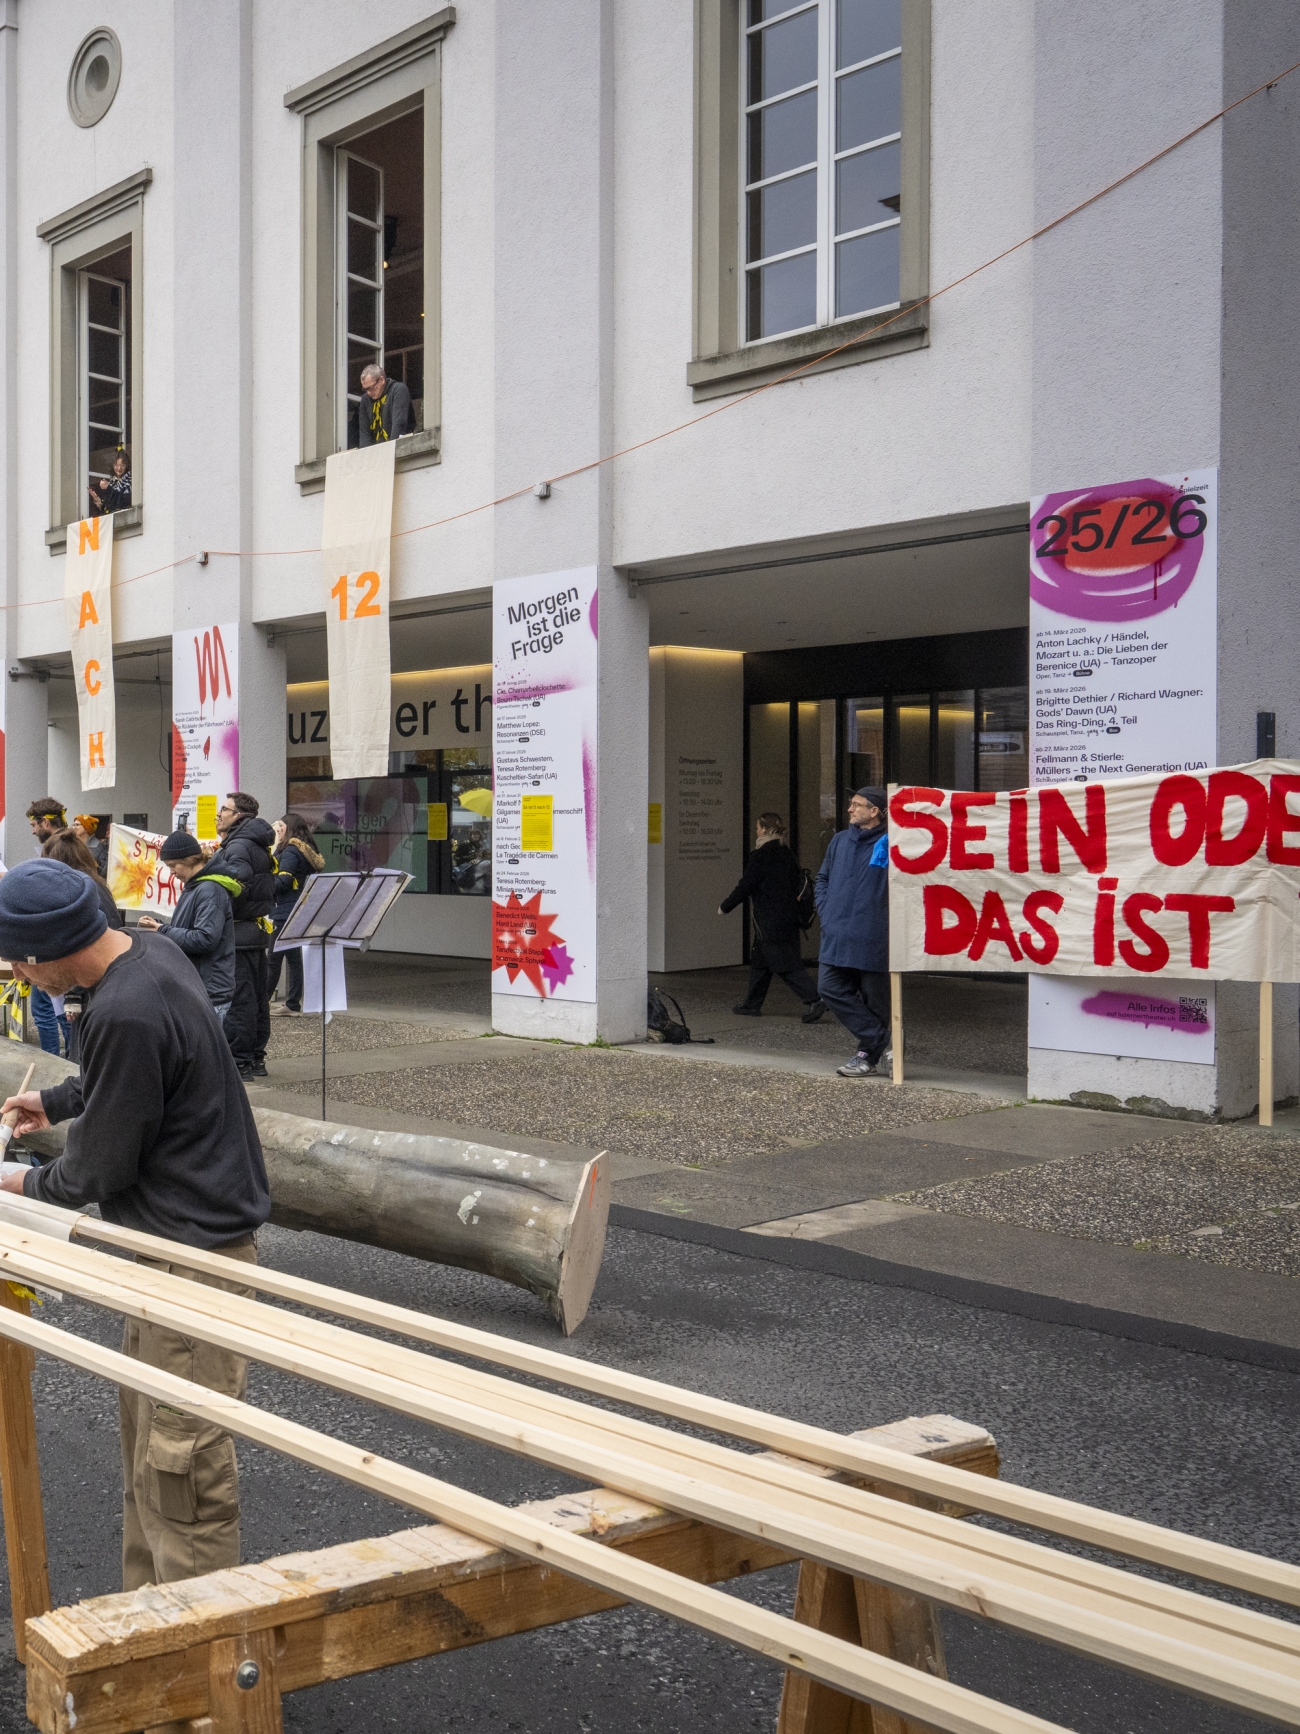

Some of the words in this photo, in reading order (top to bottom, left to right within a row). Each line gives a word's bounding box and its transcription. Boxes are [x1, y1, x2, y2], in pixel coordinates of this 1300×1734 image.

[1179, 484, 1209, 494] Spielzeit
[1036, 494, 1208, 558] 25/26
[331, 571, 381, 621] 12
[507, 587, 579, 625] Morgen
[527, 617, 549, 638] ist
[553, 607, 581, 628] die
[79, 516, 105, 768] NACH
[511, 631, 564, 660] Frage
[1036, 639, 1064, 649] Anton
[1066, 635, 1102, 647] Lachky
[1111, 631, 1149, 642] Händel,
[1036, 650, 1070, 660] Mozart
[1097, 646, 1113, 655] Die
[1115, 644, 1149, 653] Lieben
[1151, 642, 1168, 650] der
[1036, 661, 1077, 671] Berenice
[1080, 659, 1101, 670] (UA)
[1111, 656, 1156, 667] Tanzoper
[1036, 696, 1070, 707] Brigitte
[1073, 694, 1108, 704] Dethier
[1118, 691, 1156, 701] Richard
[1159, 689, 1203, 700] Wagner:
[1065, 707, 1093, 716] Dawn
[1096, 705, 1117, 716] (UA)
[1036, 720, 1054, 729] Das
[1056, 717, 1106, 729] Ring-Ding,
[1109, 717, 1118, 725] 4.
[1121, 716, 1137, 725] Teil
[530, 729, 546, 737] (DSE)
[679, 756, 717, 765] Öffnungszeiten
[1036, 754, 1078, 764] Fellmann
[1080, 754, 1088, 762] &
[1090, 753, 1124, 762] Stierle:
[1036, 765, 1070, 775] Müllers
[1081, 764, 1096, 774] the
[1099, 763, 1122, 773] Next
[1125, 761, 1181, 772] Generation
[1184, 761, 1207, 771] (UA)
[922, 884, 1065, 966] DAS
[1127, 1002, 1148, 1012] Alle
[1150, 1003, 1176, 1015] Infos
